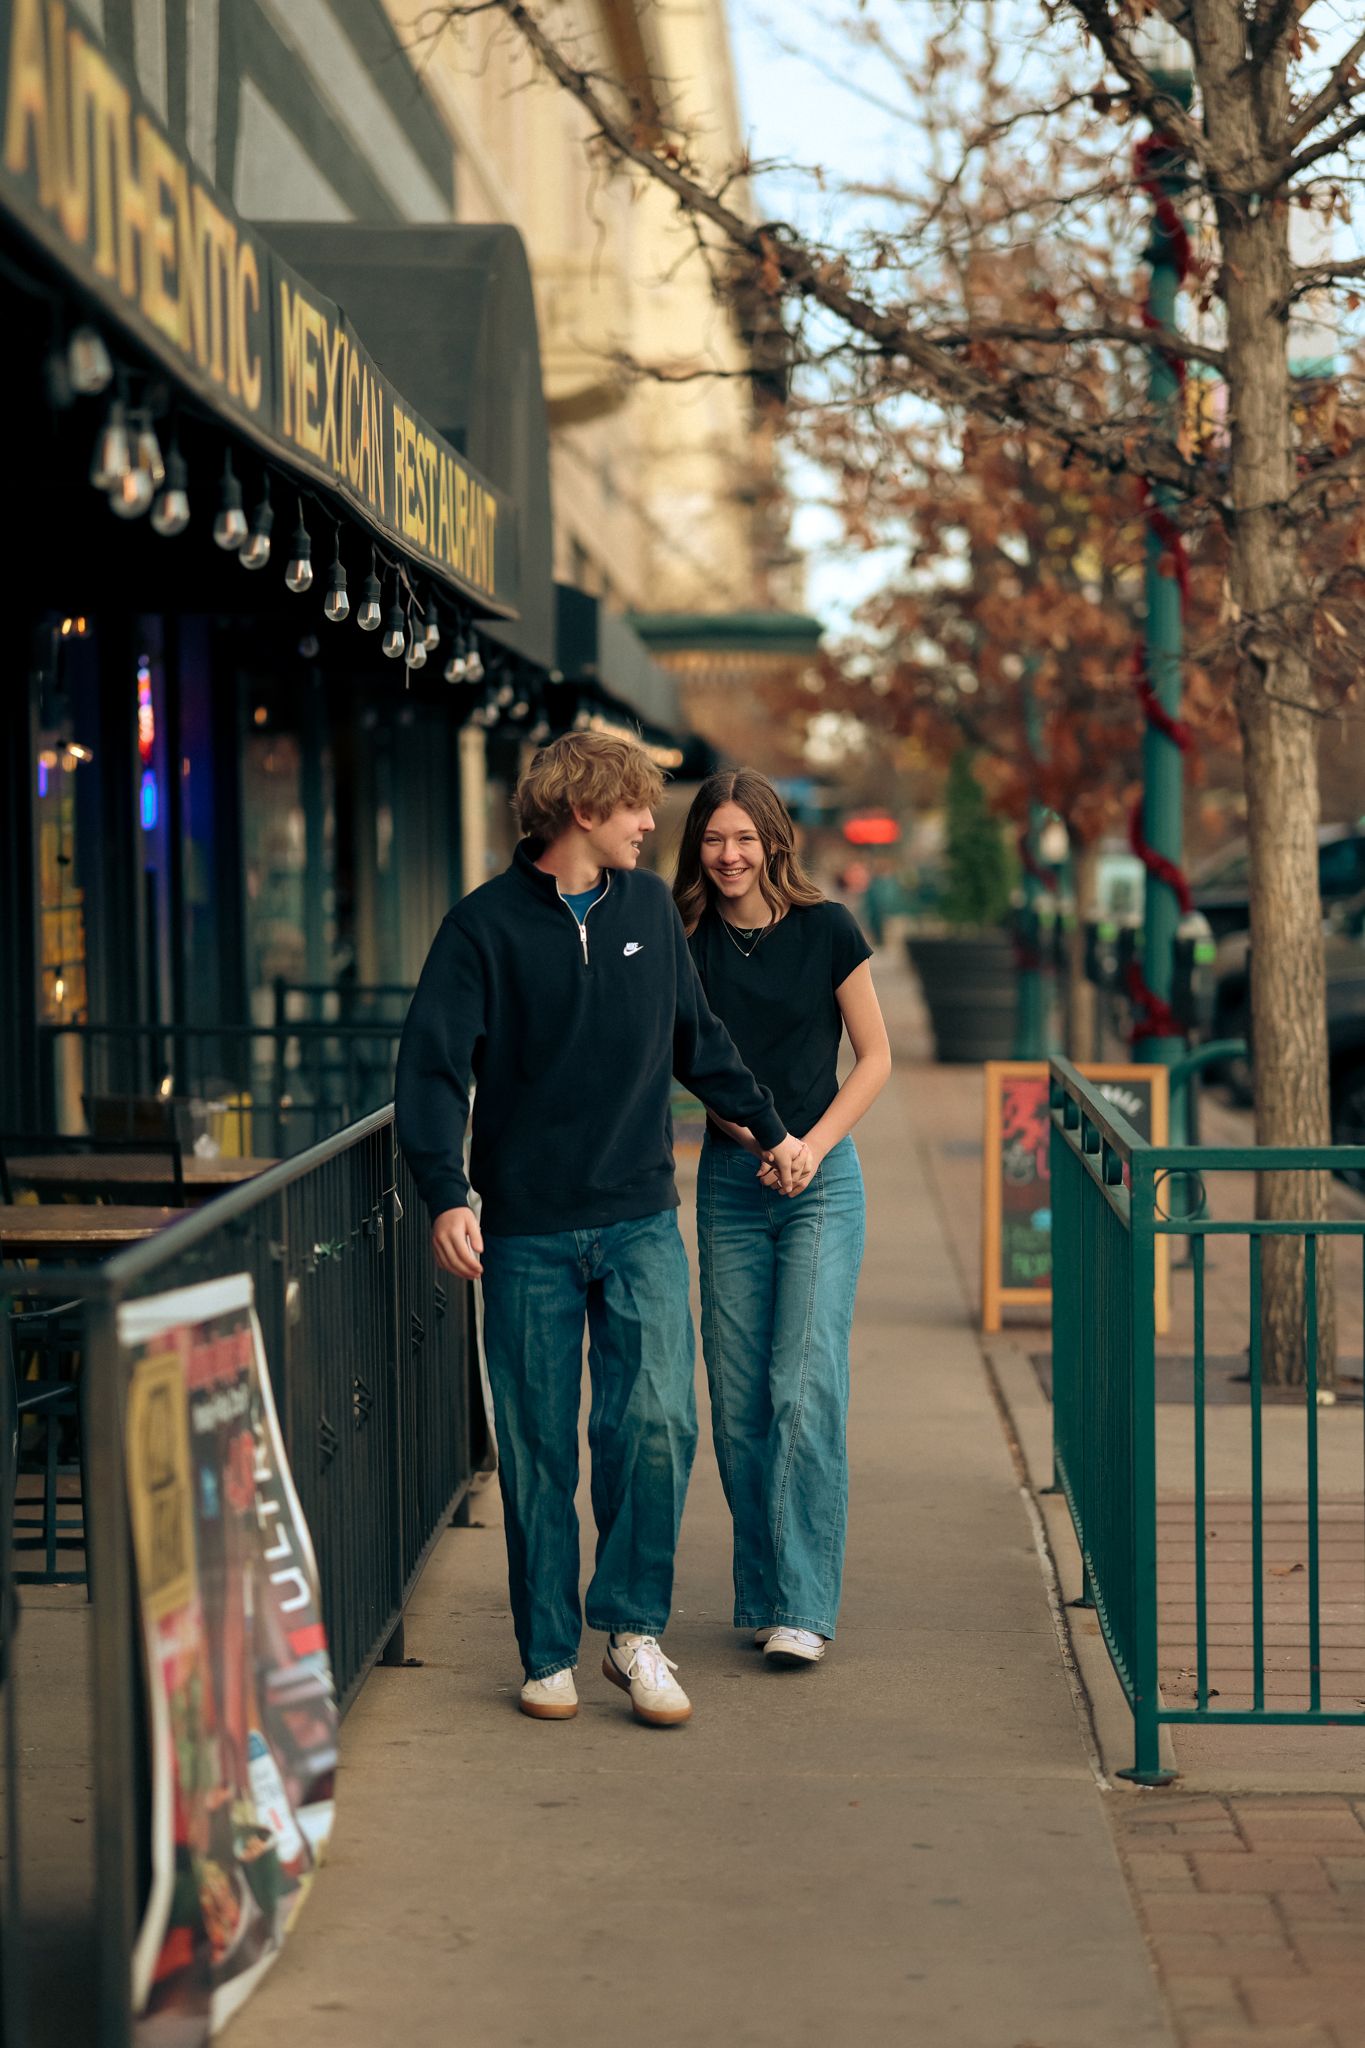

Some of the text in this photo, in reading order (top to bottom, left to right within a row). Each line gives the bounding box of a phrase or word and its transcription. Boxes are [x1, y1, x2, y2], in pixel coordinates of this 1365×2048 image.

[6, 0, 496, 595] AUTHENTIC MEXICAN RESTAURANT
